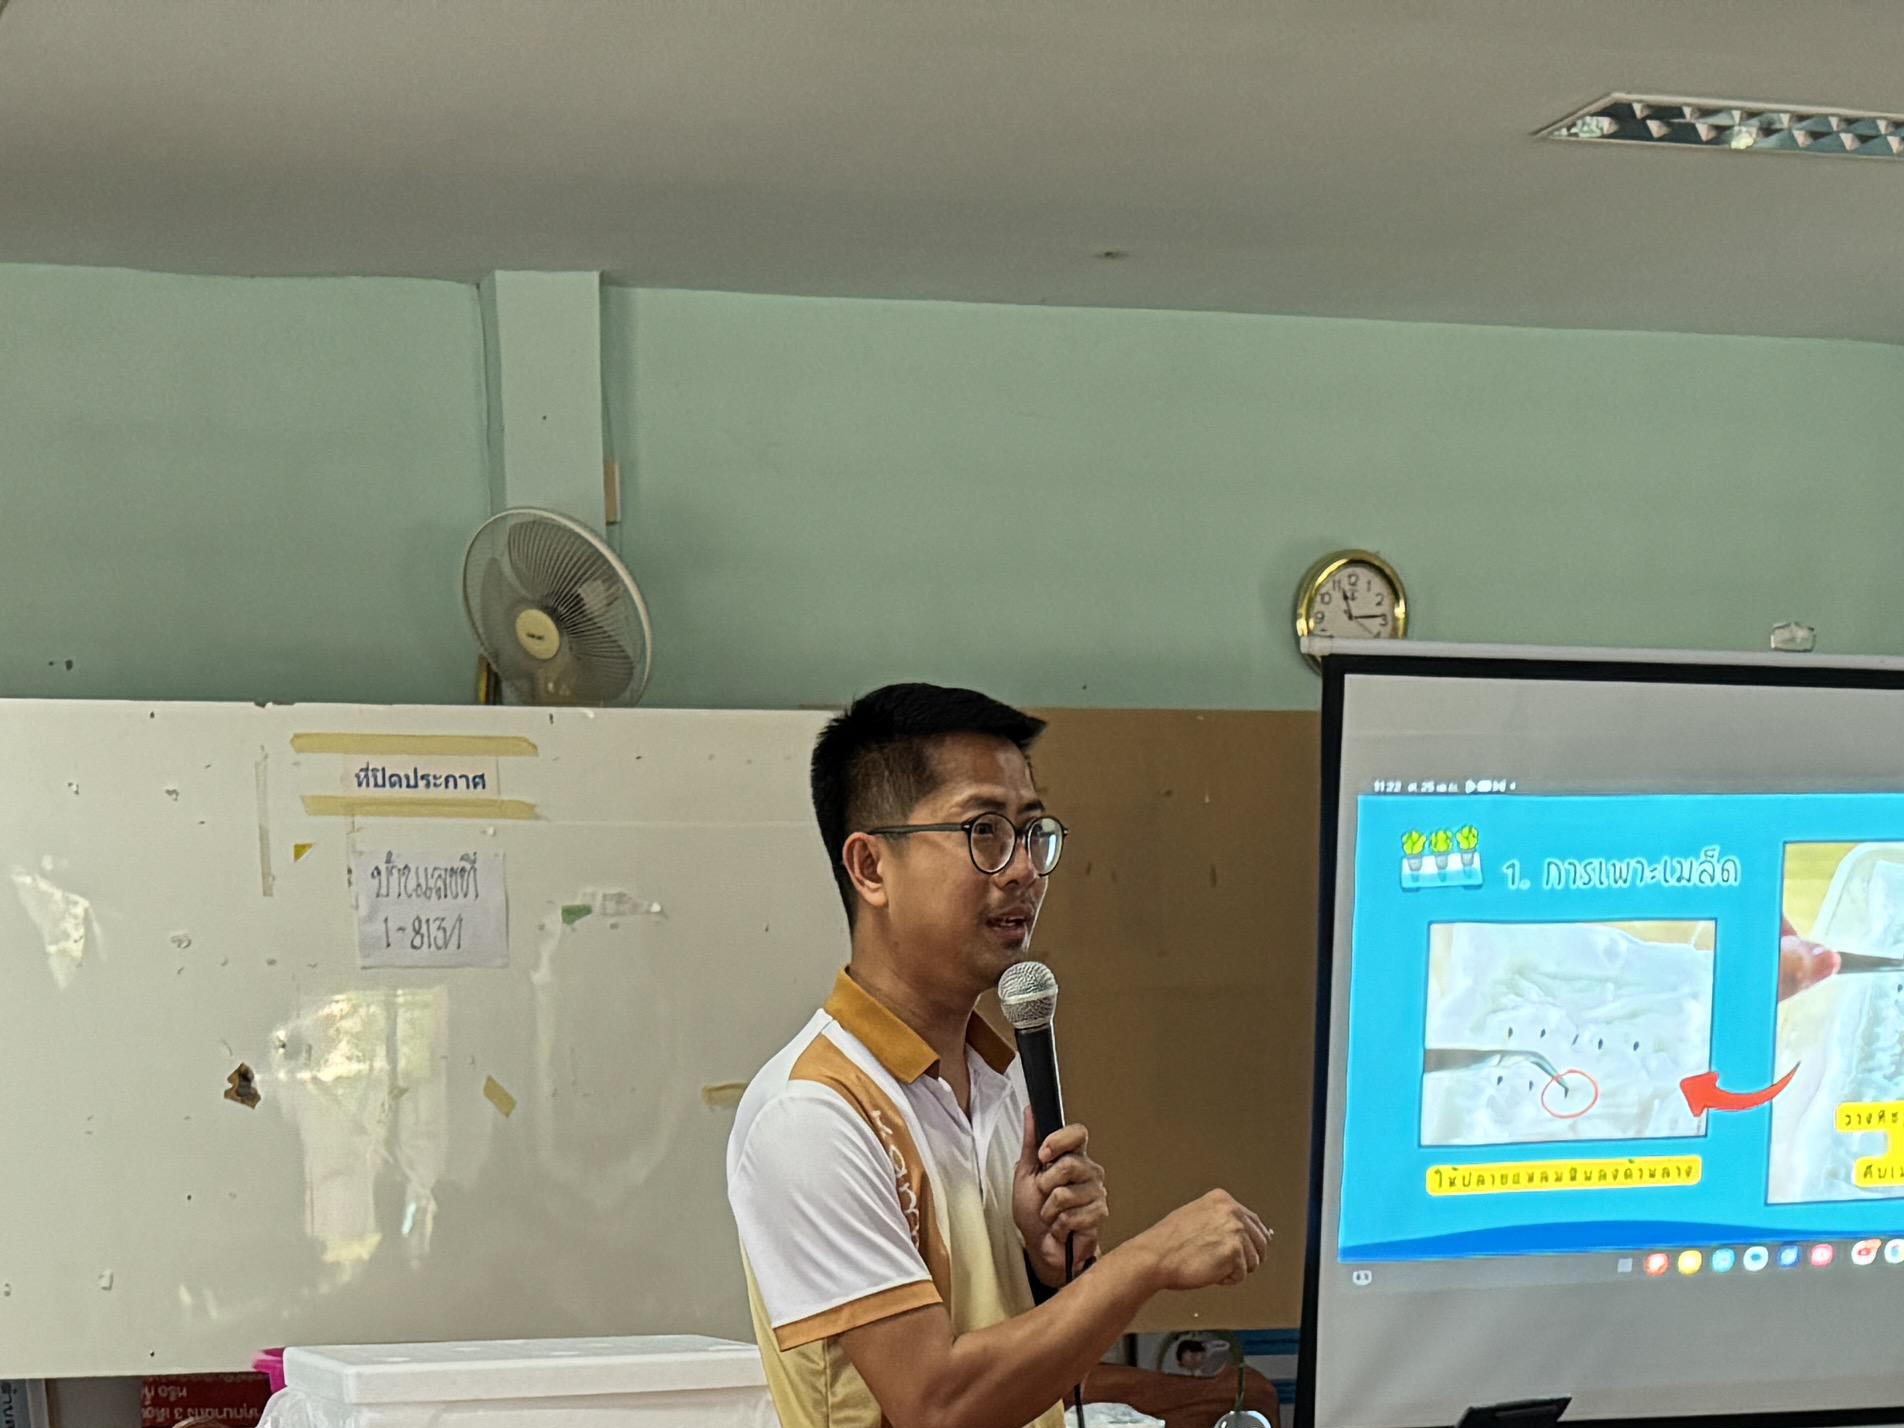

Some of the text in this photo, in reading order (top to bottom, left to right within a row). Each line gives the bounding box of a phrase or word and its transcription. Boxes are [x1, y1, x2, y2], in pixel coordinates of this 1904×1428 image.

[355, 767, 486, 790] ที่ปิดประกาศ
[1503, 844, 1741, 890] 1. การเพาะเมล็ด
